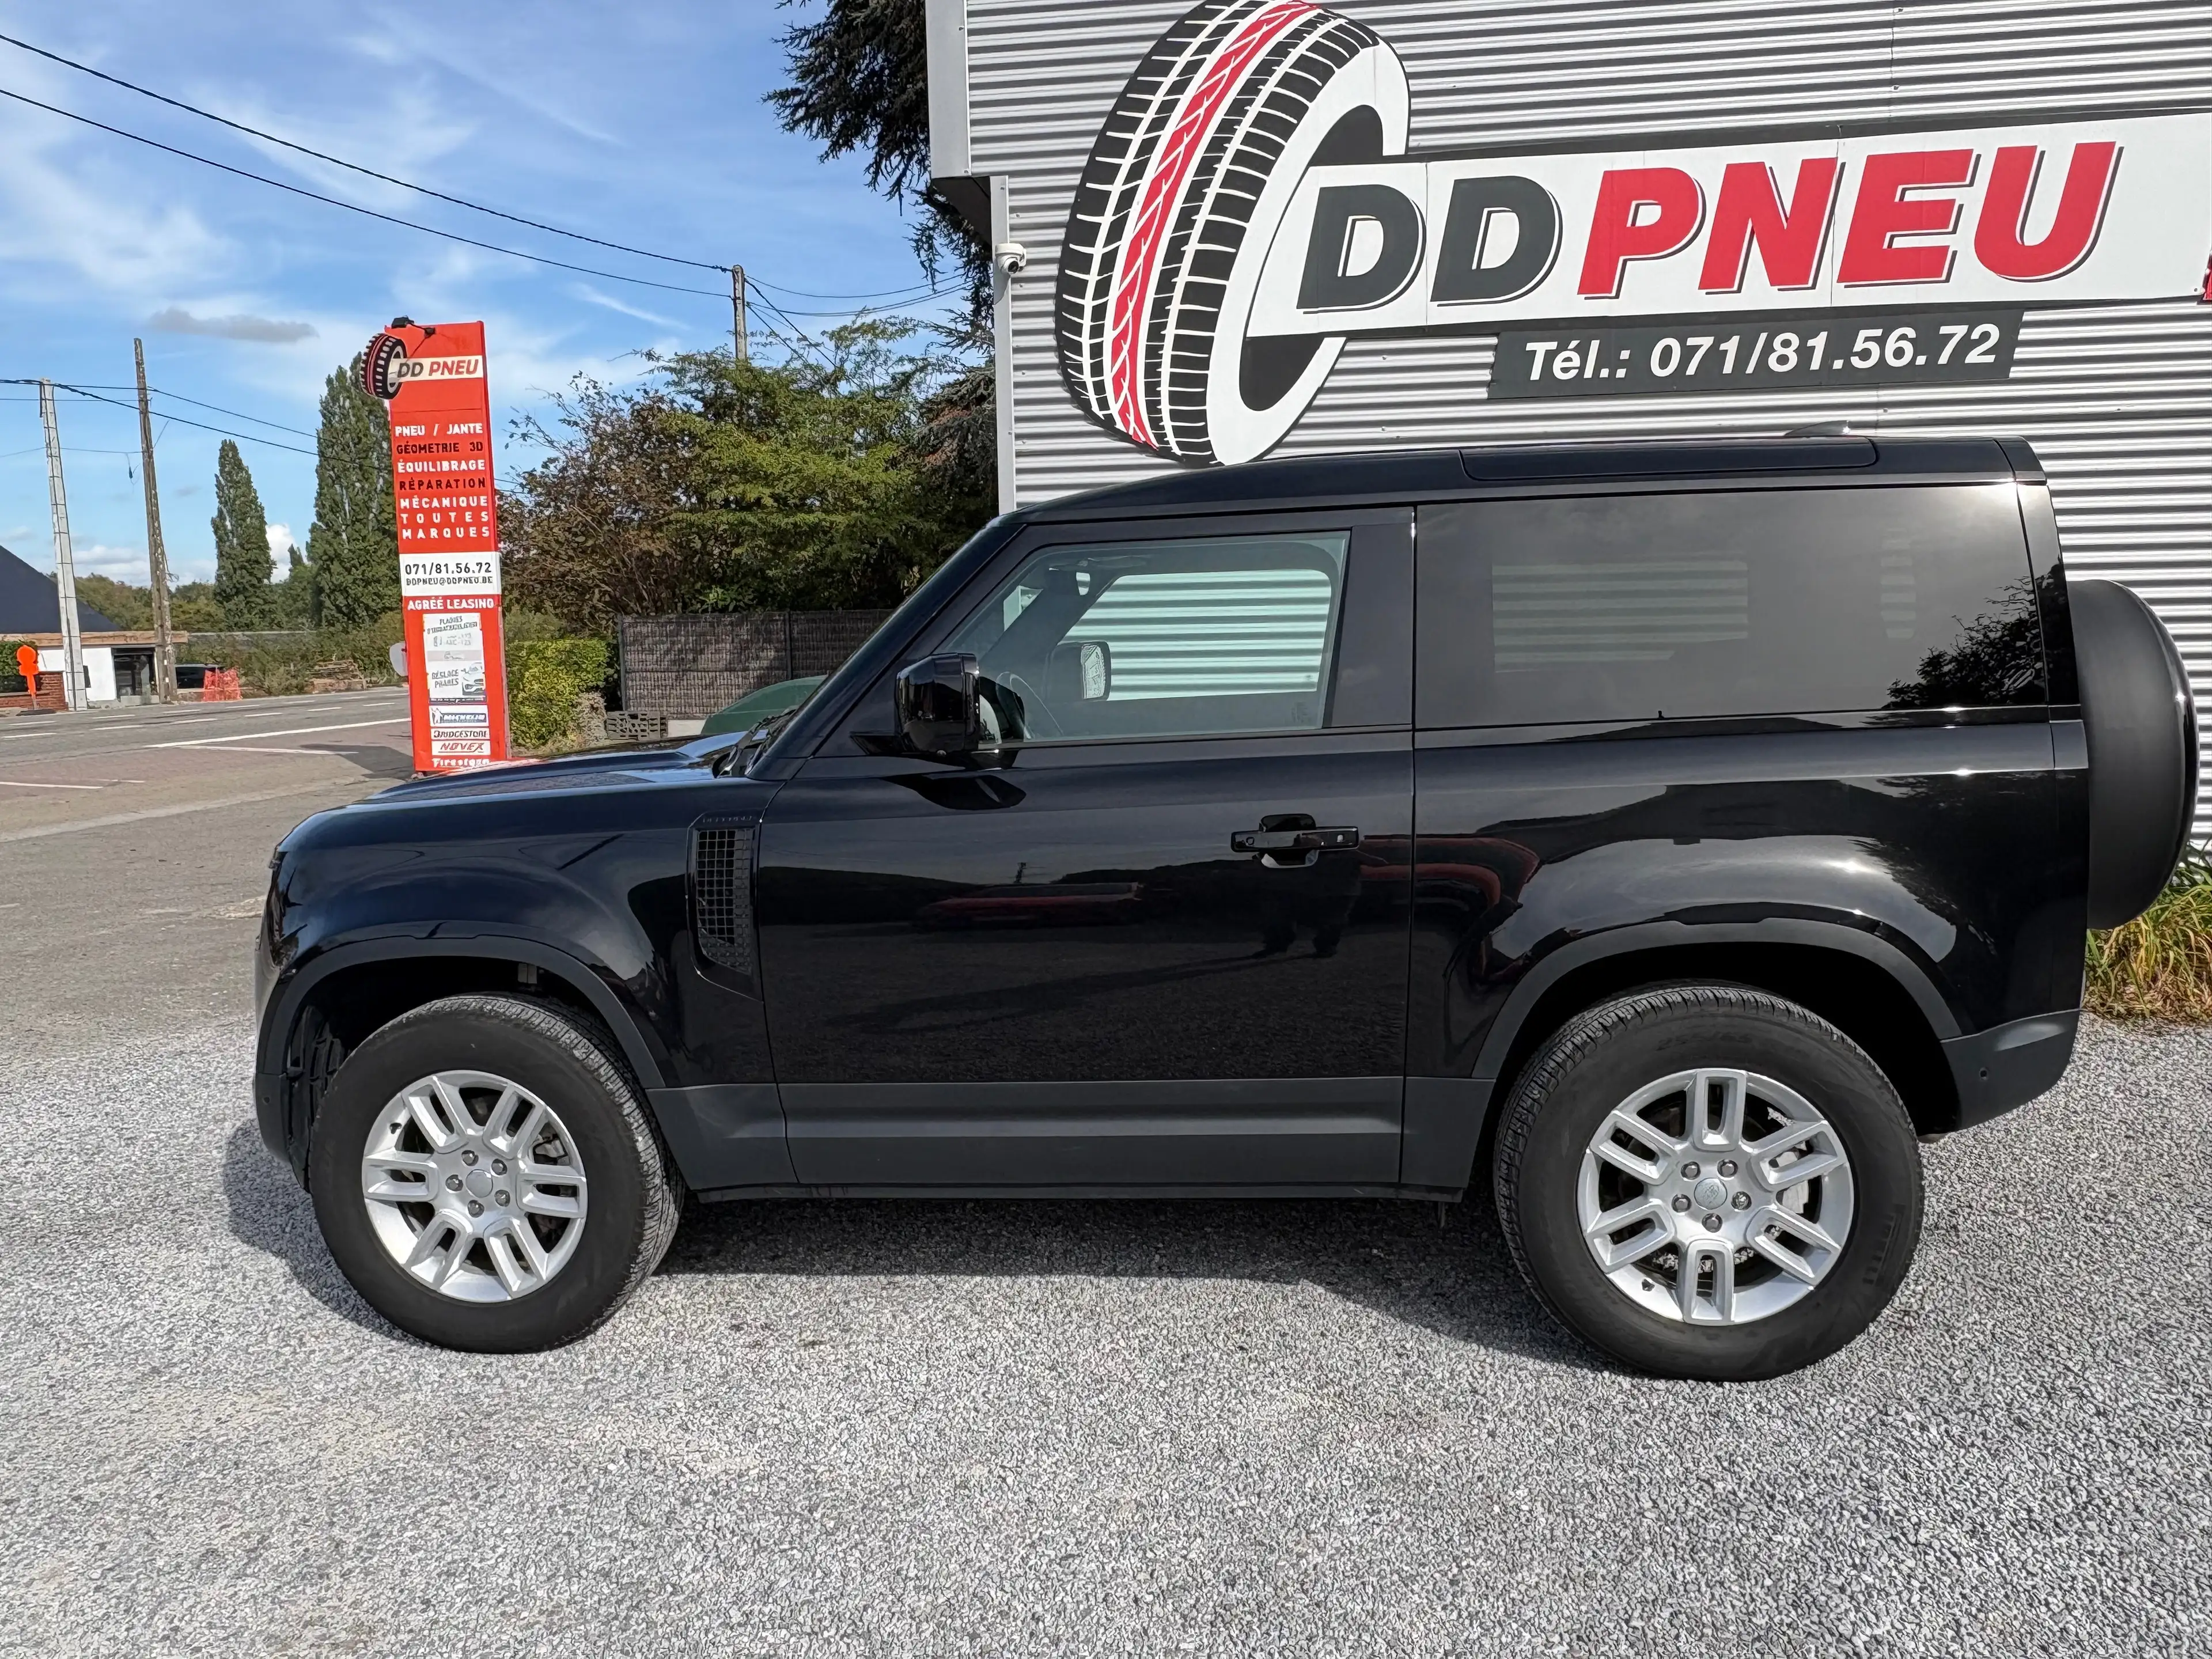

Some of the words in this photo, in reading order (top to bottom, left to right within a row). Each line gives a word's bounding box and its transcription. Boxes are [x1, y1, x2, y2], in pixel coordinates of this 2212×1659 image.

[1297, 175, 1563, 315] DD
[1577, 142, 2123, 300] PNEU
[1526, 340, 1630, 381] Tél.:
[1651, 324, 2000, 377] 071/81.56.72
[397, 362, 423, 378] DD
[429, 359, 479, 376] PNEU
[395, 425, 425, 437] PNEU
[434, 424, 440, 437] /
[446, 423, 483, 435] JANTE
[469, 442, 483, 452] 3D
[397, 459, 486, 474] ÉQUILIBRAGE
[399, 477, 486, 491] RÉPARATION
[400, 495, 488, 509] MÉCANIQUE
[400, 511, 489, 524] TOUTES
[402, 527, 490, 540] MARQUES
[405, 562, 492, 575] 071/81.56.72
[407, 596, 444, 611] AGRÉÉ
[446, 598, 494, 609] LEASING
[440, 742, 484, 751] NOVEX
